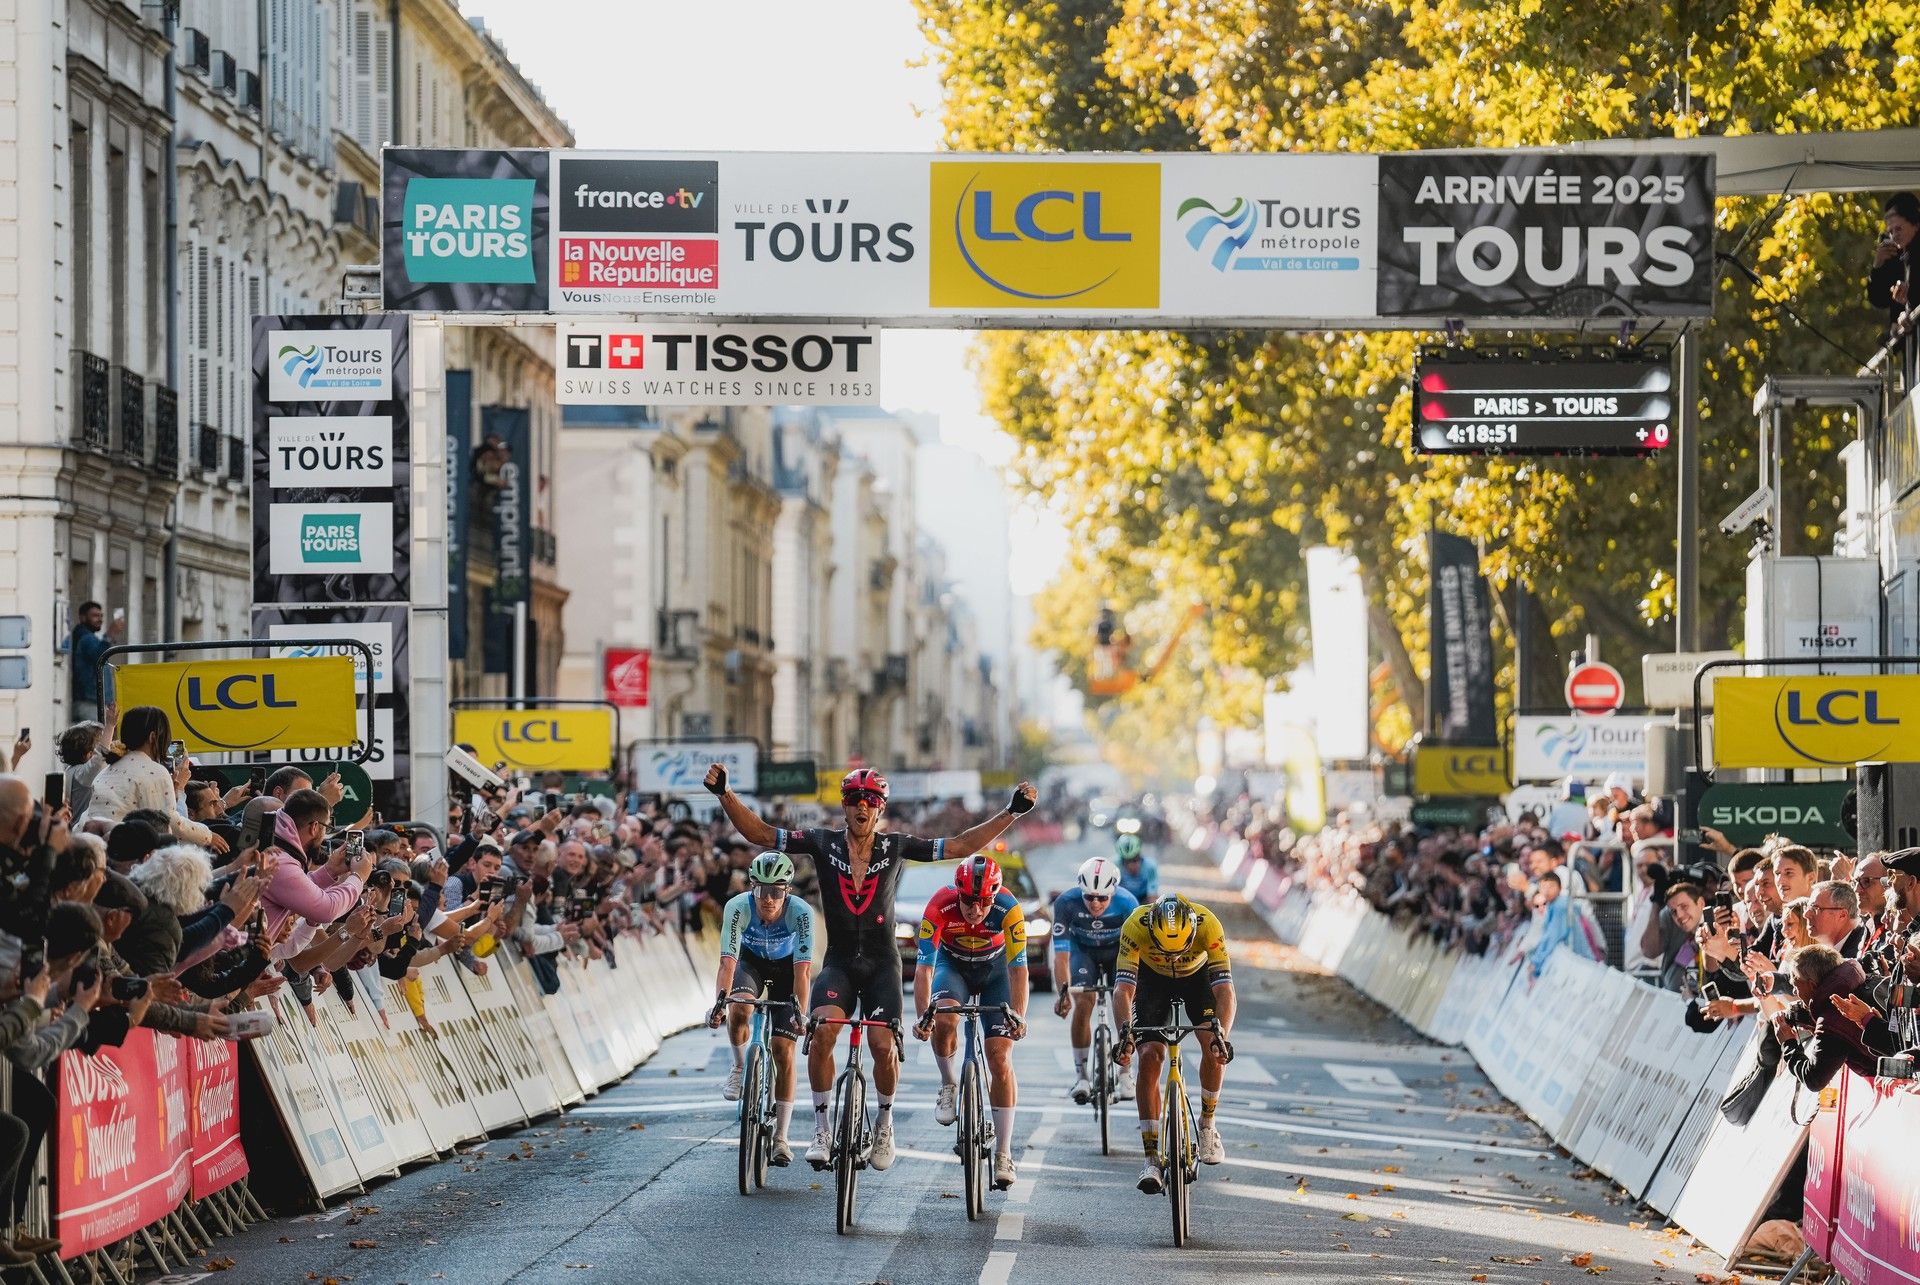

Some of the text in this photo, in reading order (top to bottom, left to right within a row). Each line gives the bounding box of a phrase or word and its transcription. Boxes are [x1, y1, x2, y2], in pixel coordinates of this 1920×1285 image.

[1414, 167, 1686, 204] ARRIVÉE 2025
[415, 204, 521, 230] PARIS
[734, 203, 798, 214] VILLE DE
[973, 190, 1132, 242] LCL
[1257, 199, 1361, 229] Tours
[407, 231, 528, 258] TOURS
[564, 240, 685, 262] la Nouvelle
[734, 221, 915, 263] TOURS
[1261, 235, 1360, 252] métropole
[1261, 258, 1340, 270] Val de Loire
[1402, 225, 1695, 287] TOURS
[589, 262, 714, 287] République
[323, 345, 383, 363] Tours
[652, 334, 873, 373] TISSOT
[326, 366, 383, 377] métropole
[326, 379, 338, 387] Val
[340, 379, 350, 387] de
[564, 380, 873, 397] SWISS WATCHES SINCE 1853
[1473, 397, 1530, 416] PARIS
[1552, 397, 1619, 416] TOURS
[1445, 424, 1518, 444] 4:18:51
[277, 445, 384, 471] TOURS
[305, 525, 356, 540] PARIS
[302, 538, 359, 552] TOURS
[1799, 637, 1858, 647] TISSOT
[187, 673, 298, 711] LCL
[1787, 690, 1900, 725] LCL
[503, 719, 573, 742] LCL
[730, 908, 741, 945] DECATHLON
